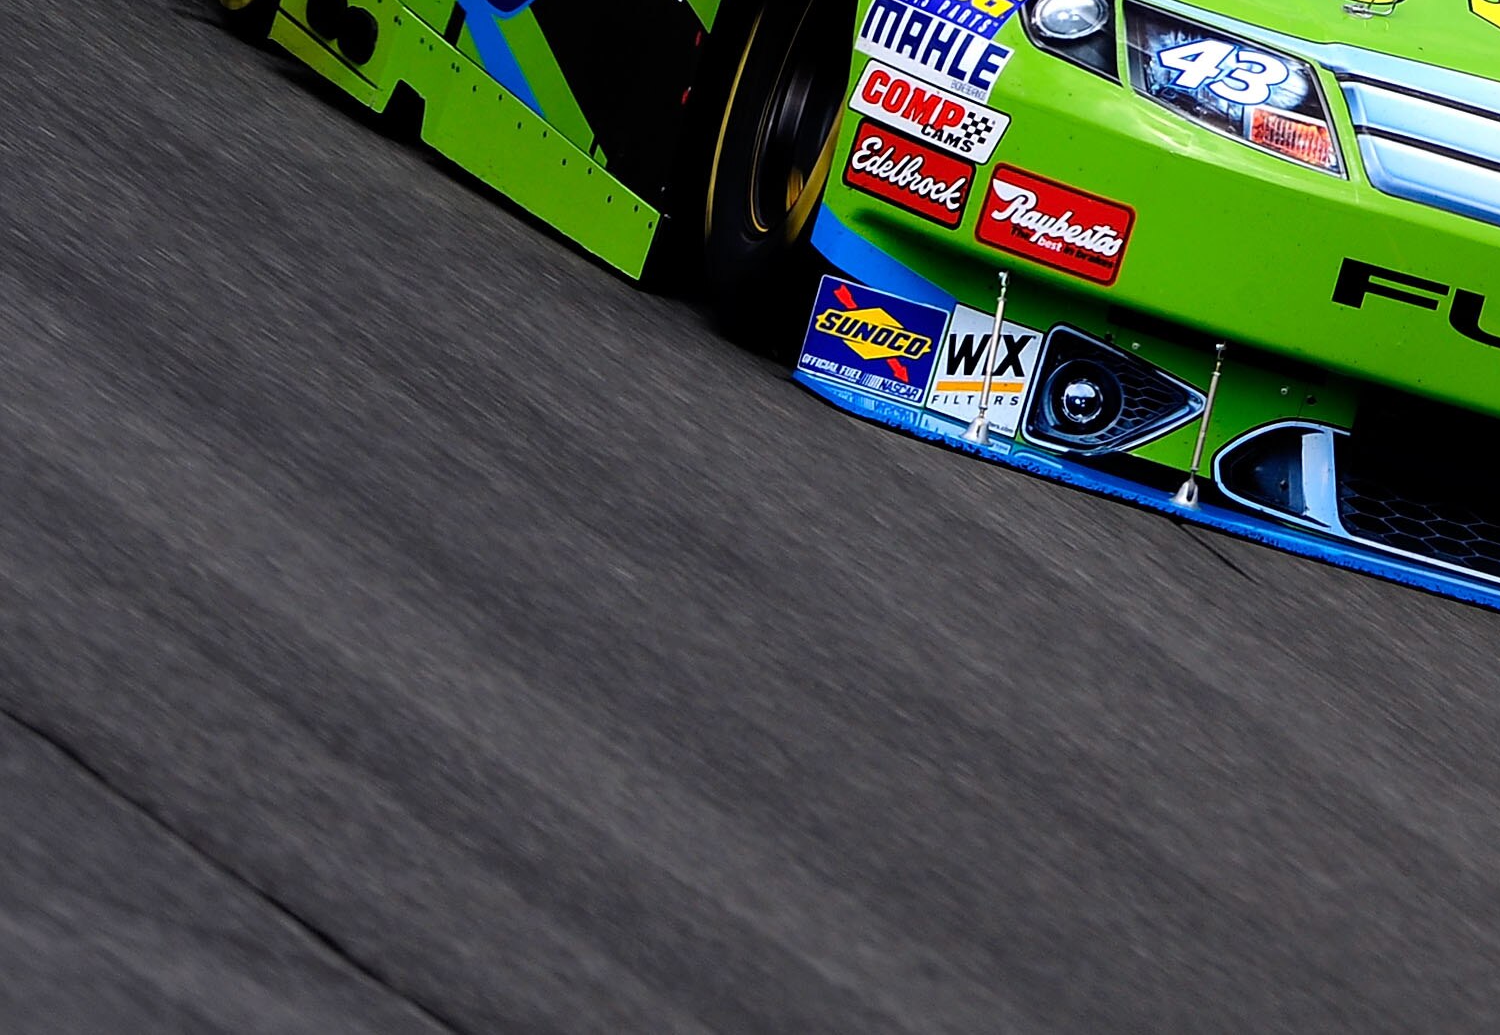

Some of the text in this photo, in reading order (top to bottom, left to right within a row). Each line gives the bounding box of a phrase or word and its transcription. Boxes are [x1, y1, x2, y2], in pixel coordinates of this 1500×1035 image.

[937, 0, 992, 34] PARTS
[1157, 38, 1290, 105] 43
[861, 69, 966, 131] COMP
[920, 123, 975, 153] CAMS
[851, 136, 967, 210] Edelbrock
[991, 178, 1123, 256] Raybestos
[1011, 226, 1030, 240] The
[1037, 236, 1063, 253] best
[818, 311, 929, 356] SUNOCO
[801, 353, 924, 402] OFFICIAL FUEL NASCAR
[931, 395, 1020, 406] FILTRS
